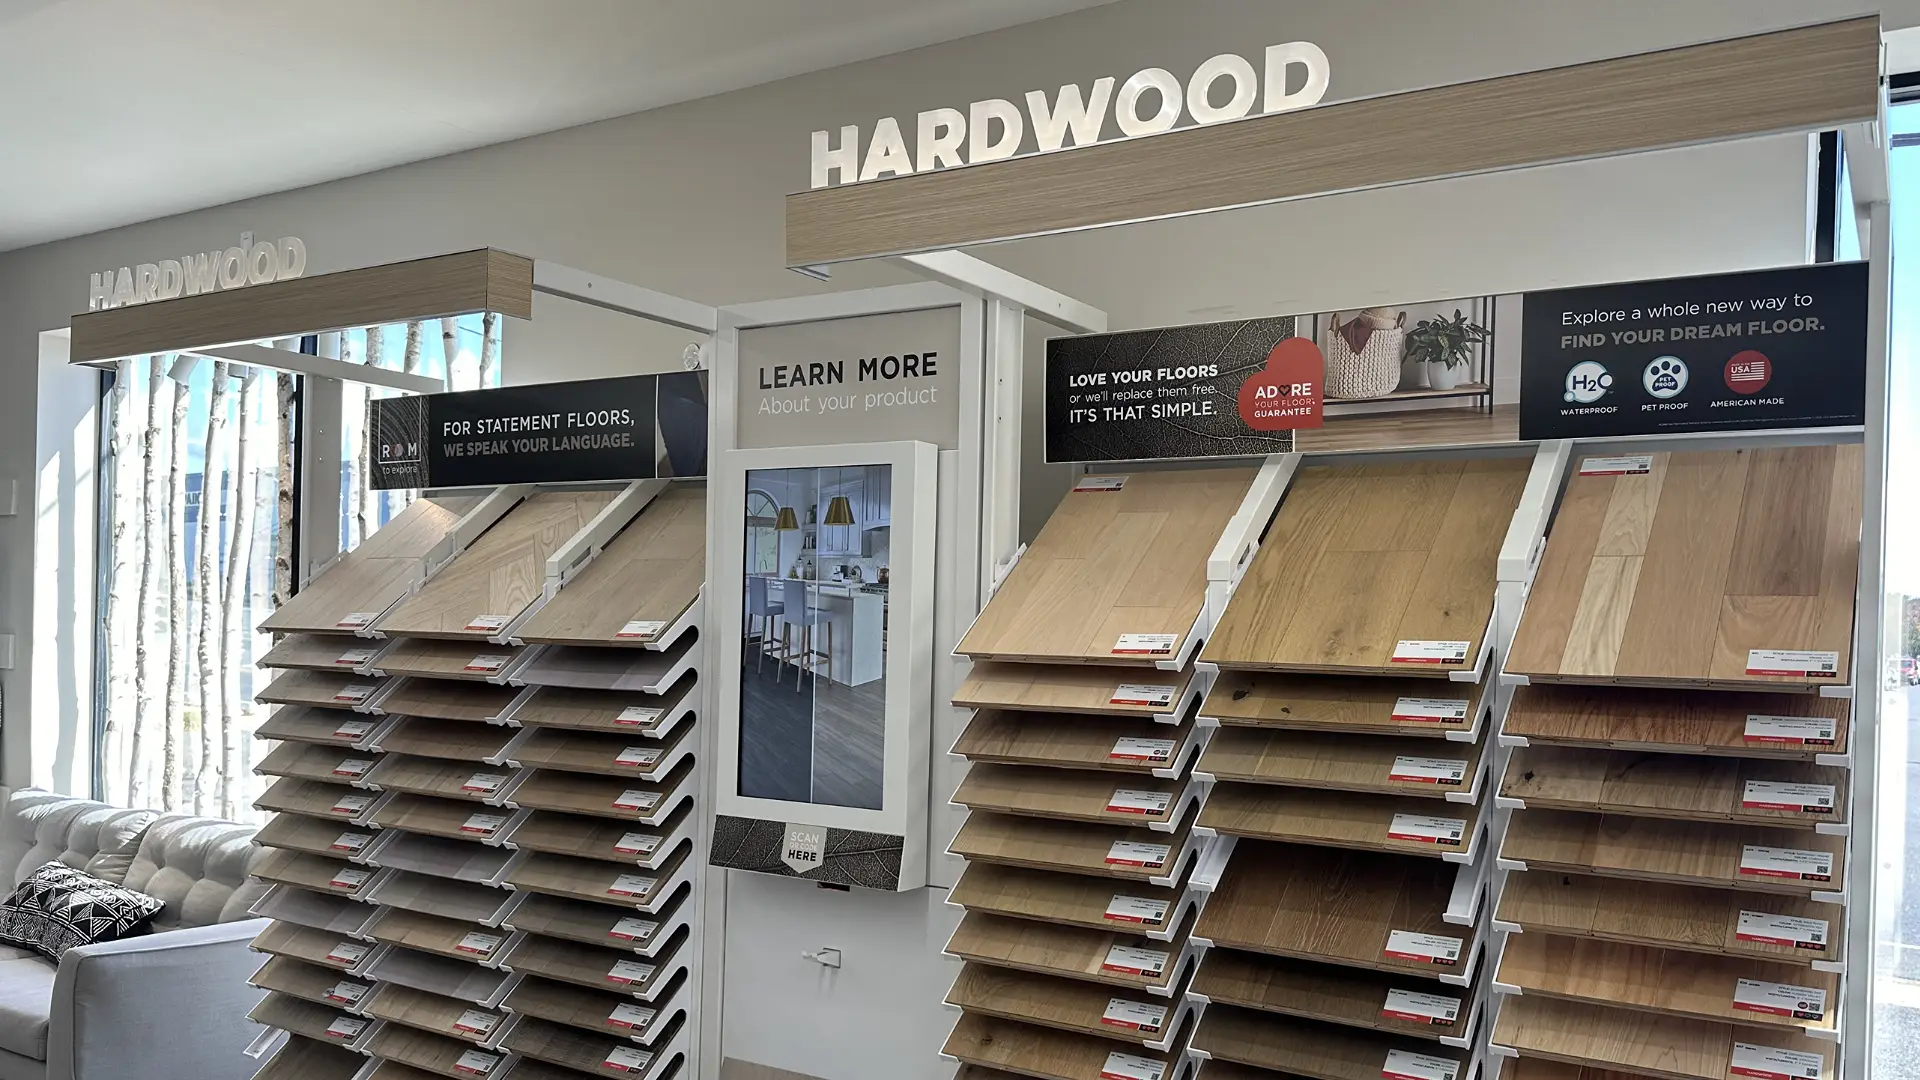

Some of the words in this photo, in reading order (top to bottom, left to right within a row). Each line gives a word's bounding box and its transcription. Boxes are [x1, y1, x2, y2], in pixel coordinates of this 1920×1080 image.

[810, 41, 1331, 189] HARDWOOD
[89, 236, 307, 312] HARDWOOD
[1562, 308, 1626, 327] Explore
[1631, 309, 1641, 320] a
[1647, 301, 1700, 318] whole
[1706, 300, 1743, 314] new
[1750, 295, 1787, 312] way
[1794, 292, 1813, 307] to
[1560, 333, 1606, 349] FIND
[1611, 329, 1664, 346] YOUR
[1671, 322, 1742, 341] DREAM
[1748, 317, 1825, 336] FLOOR.
[759, 360, 844, 390] LEARN
[858, 352, 938, 382] MORE
[1069, 372, 1107, 388] LOVE
[1111, 369, 1152, 385] YOUR
[1157, 364, 1218, 381] FLOORS
[1731, 365, 1750, 374] USA
[758, 395, 810, 415] About
[818, 394, 857, 415] your
[865, 386, 938, 411] product
[1069, 394, 1081, 404] or
[1085, 390, 1108, 403] we'll
[1112, 388, 1153, 403] replace
[1157, 386, 1188, 399] them
[1192, 384, 1218, 396] free.
[1254, 400, 1278, 409] YOUR
[1710, 398, 1756, 408] AMERICAN
[1758, 397, 1785, 406] MADE
[1069, 407, 1097, 424] IT'S
[1102, 405, 1143, 422] THAT
[1151, 401, 1218, 419] SIMPLE.
[1254, 407, 1312, 418] GUARANTEE
[1560, 406, 1618, 416] WATERPROOF
[1641, 404, 1657, 412] PET
[1660, 402, 1688, 410] PROOF
[444, 421, 471, 437] FOR
[476, 414, 560, 434] STATEMENT
[568, 408, 635, 432] FLOORS,
[444, 442, 464, 457] WE
[467, 440, 508, 456] SPEAK
[512, 437, 549, 453] YOUR
[552, 432, 635, 450] LANGUAGE.
[382, 466, 390, 475] to
[392, 465, 418, 476] explore
[790, 831, 820, 844] SCAN
[788, 849, 817, 862] HERE
